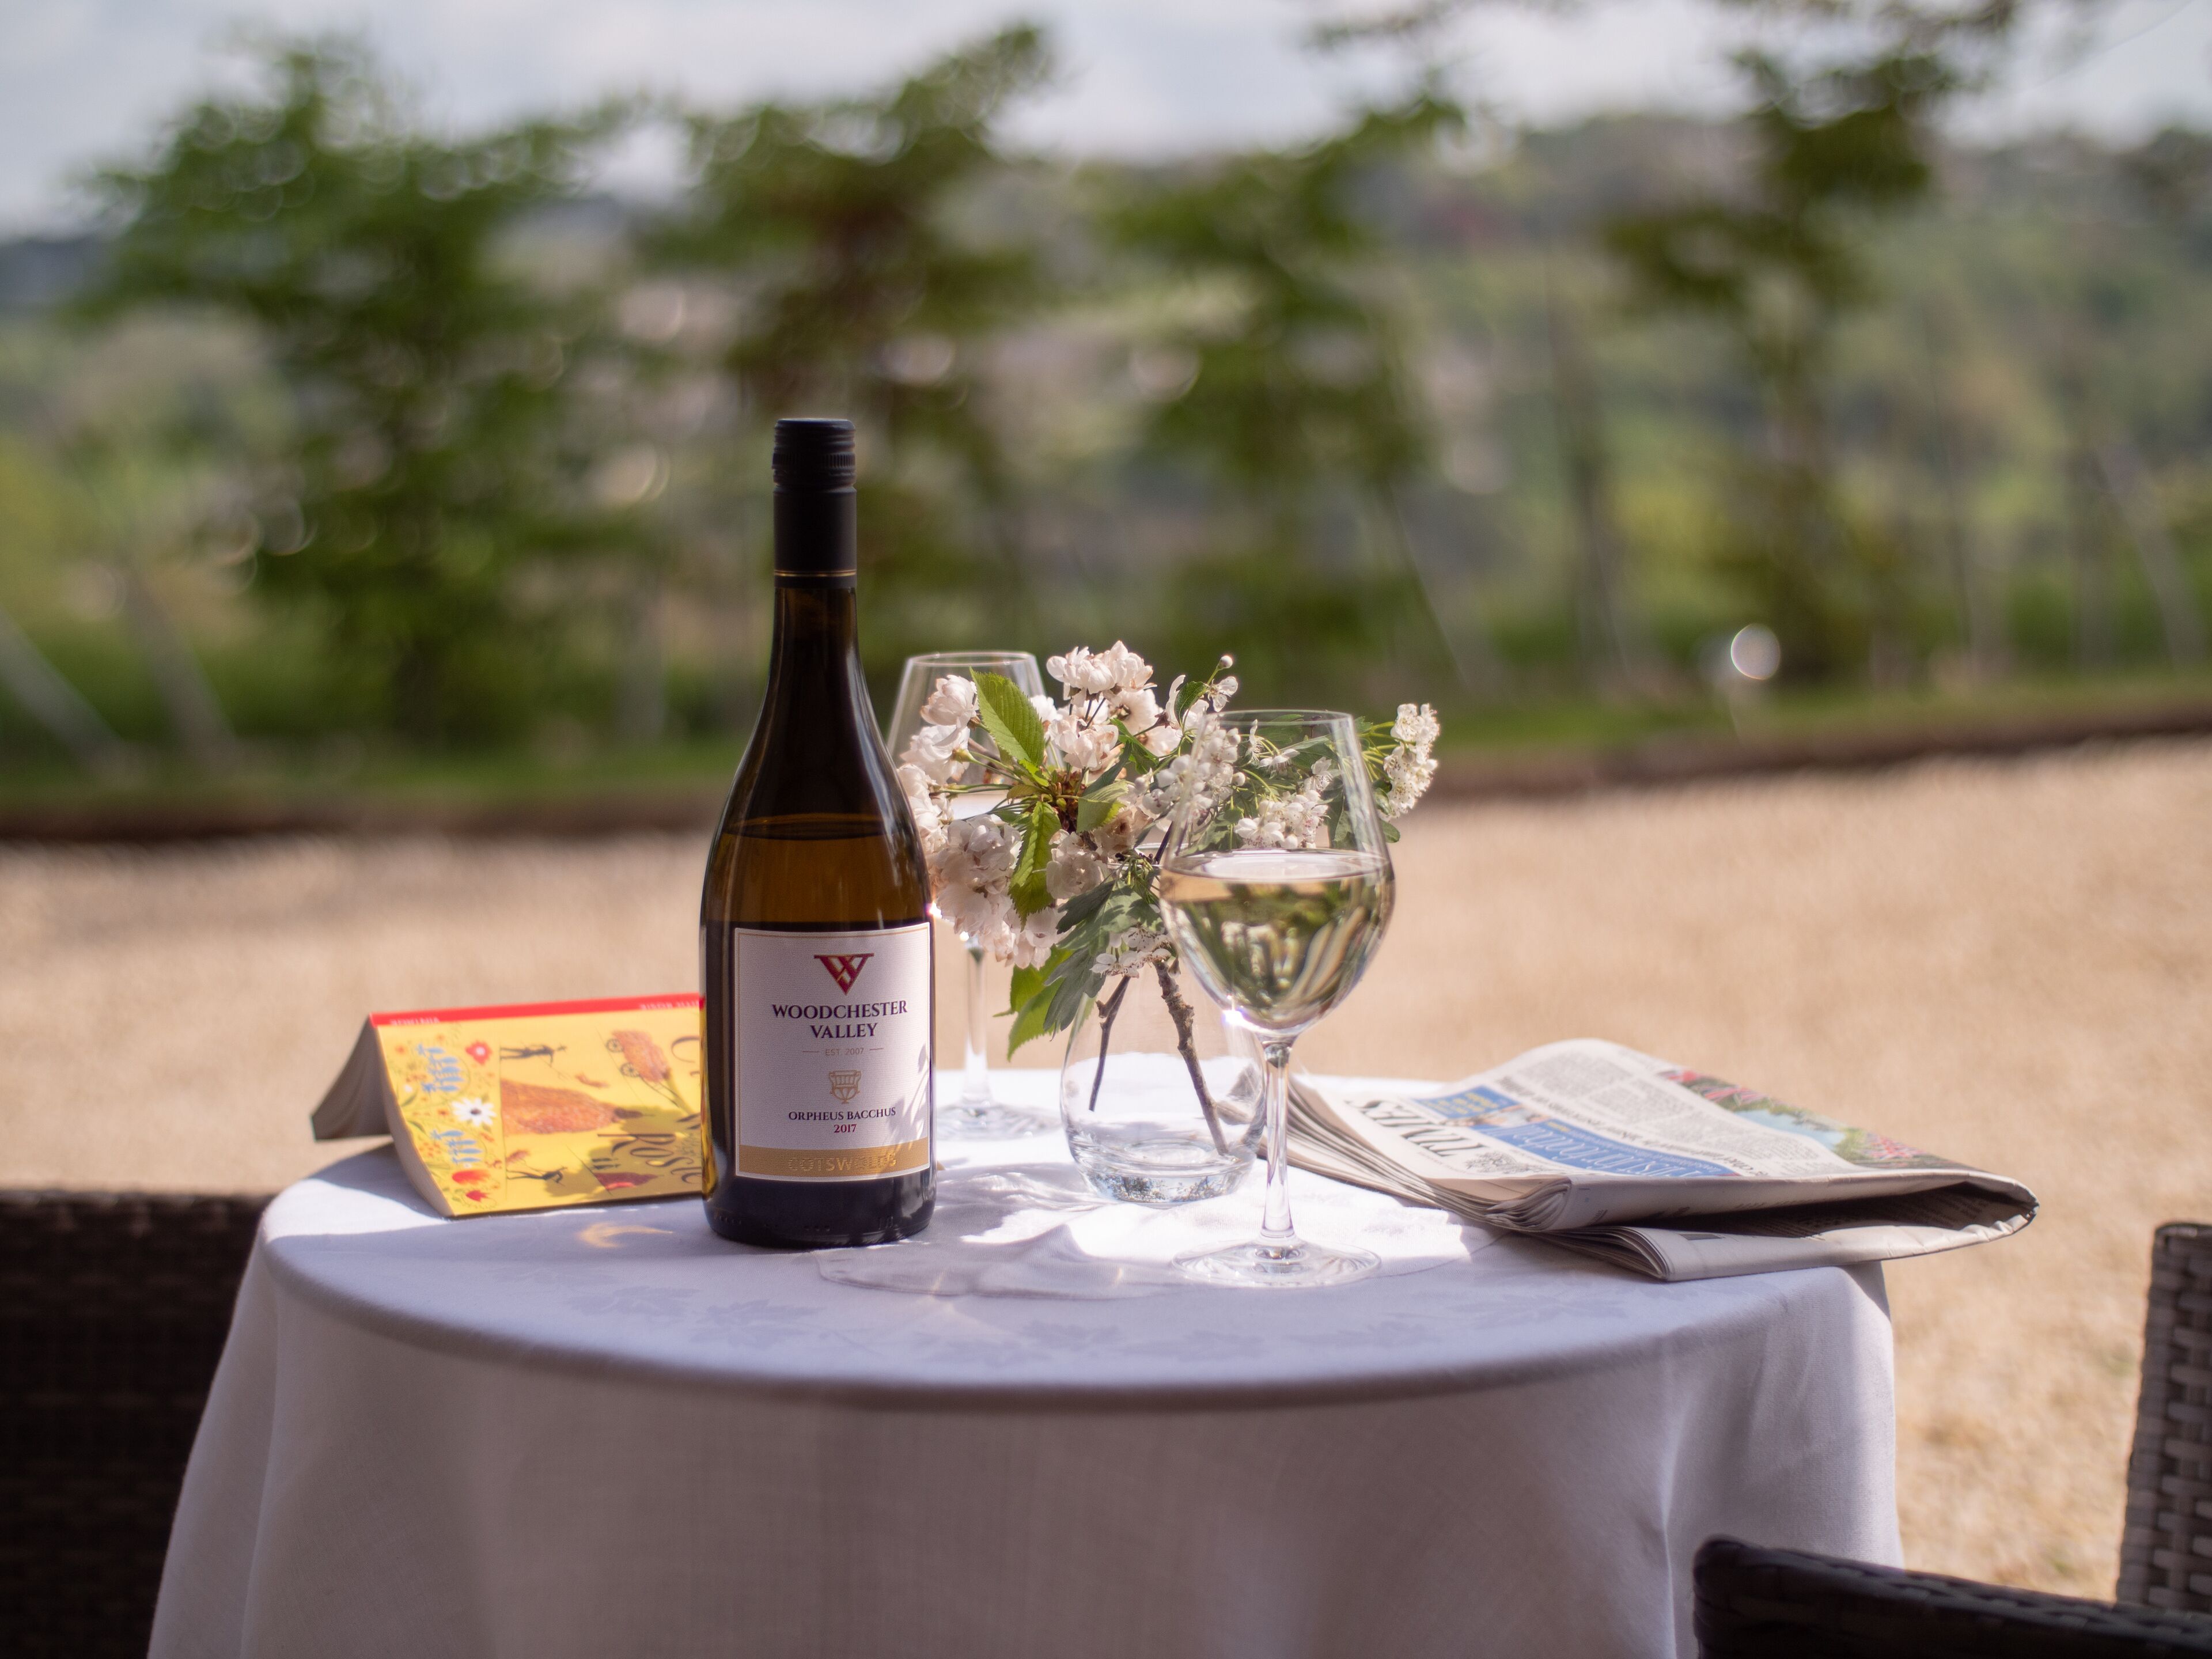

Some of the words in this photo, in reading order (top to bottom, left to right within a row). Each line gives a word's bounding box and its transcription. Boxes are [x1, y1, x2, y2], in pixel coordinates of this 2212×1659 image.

[771, 1000, 908, 1019] WOODCHESTER
[810, 1022, 878, 1039] VALLEY
[844, 1047, 865, 1056] 2007
[788, 1111, 844, 1121] ORPHEUS
[847, 1107, 896, 1120] BACCHUS
[834, 1123, 857, 1134] 2017
[1343, 1099, 1490, 1157] TIMES
[787, 1152, 897, 1172] COTSWOLDS
